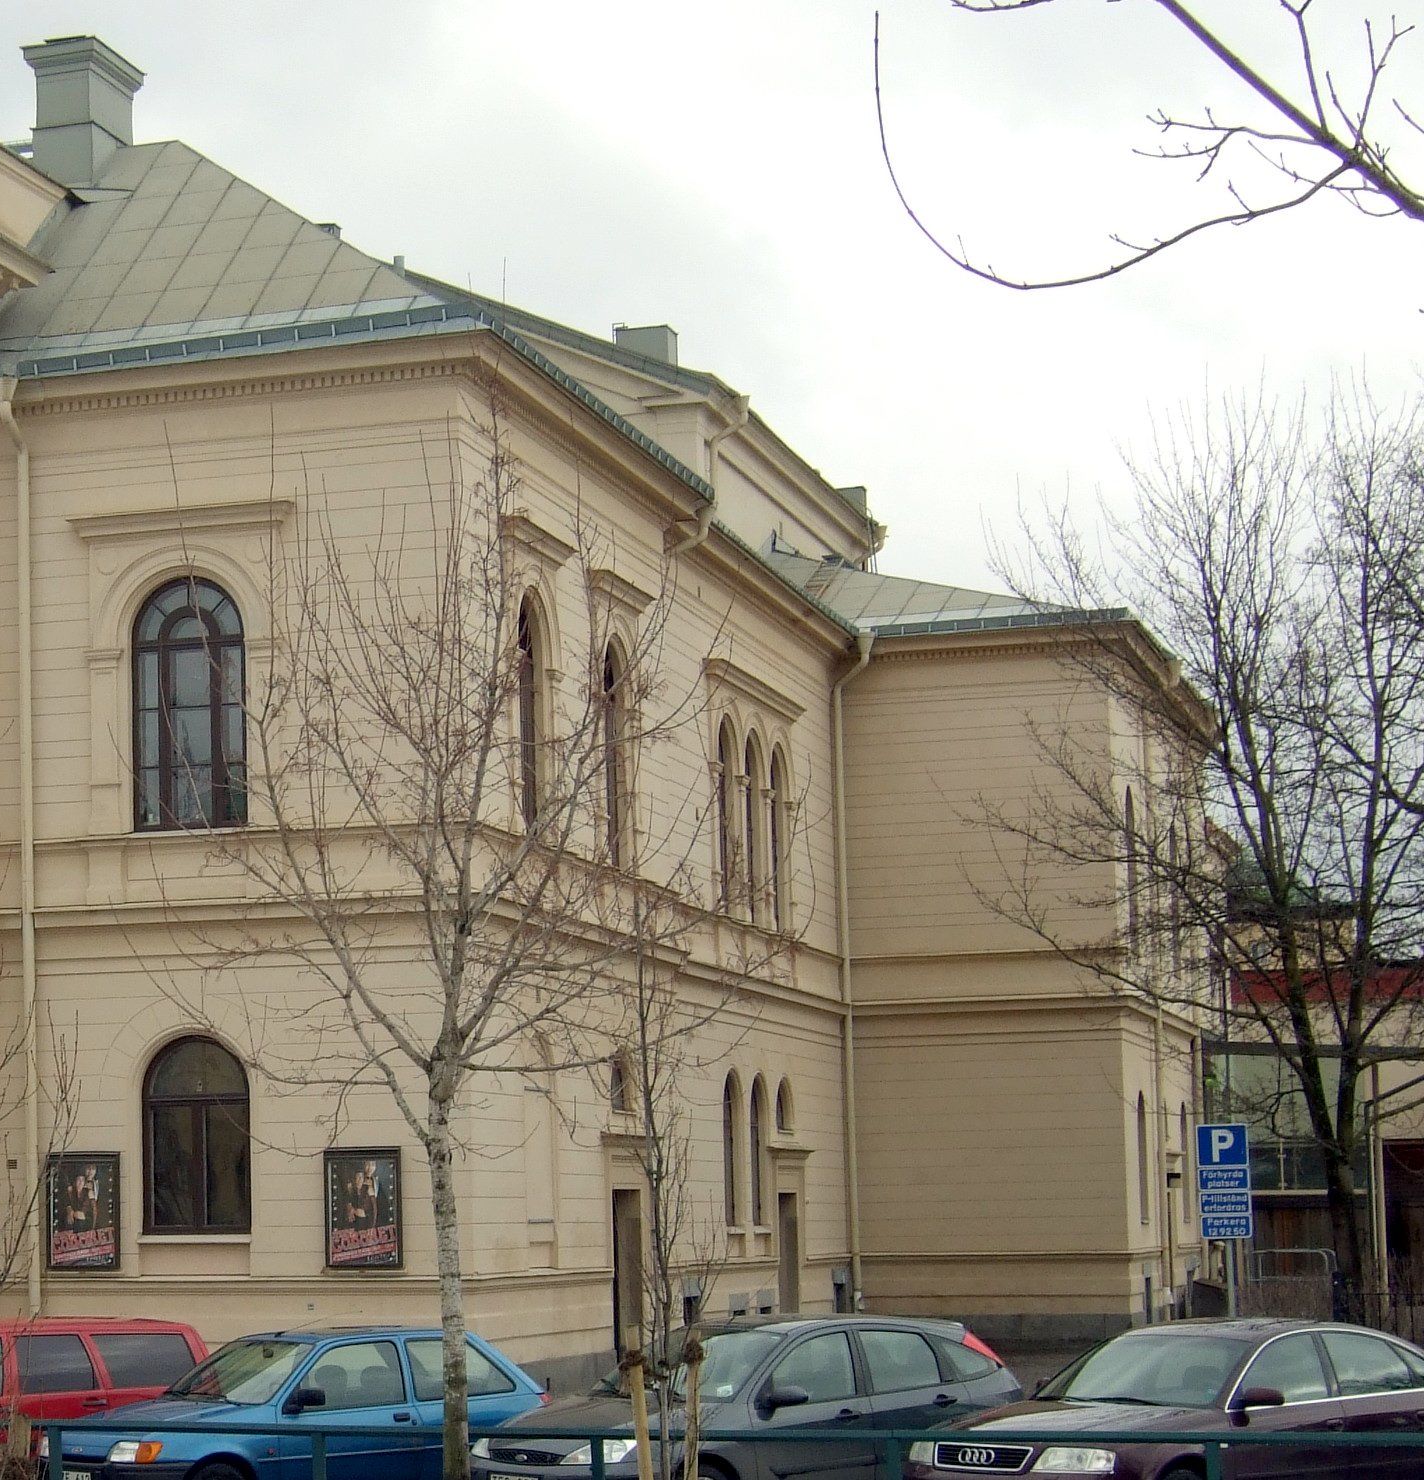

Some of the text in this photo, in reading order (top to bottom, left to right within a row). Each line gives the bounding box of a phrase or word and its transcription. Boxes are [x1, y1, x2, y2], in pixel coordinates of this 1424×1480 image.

[1211, 1129, 1235, 1163] P
[1207, 1180, 1240, 1188] platser
[1207, 1218, 1246, 1226] Parkera
